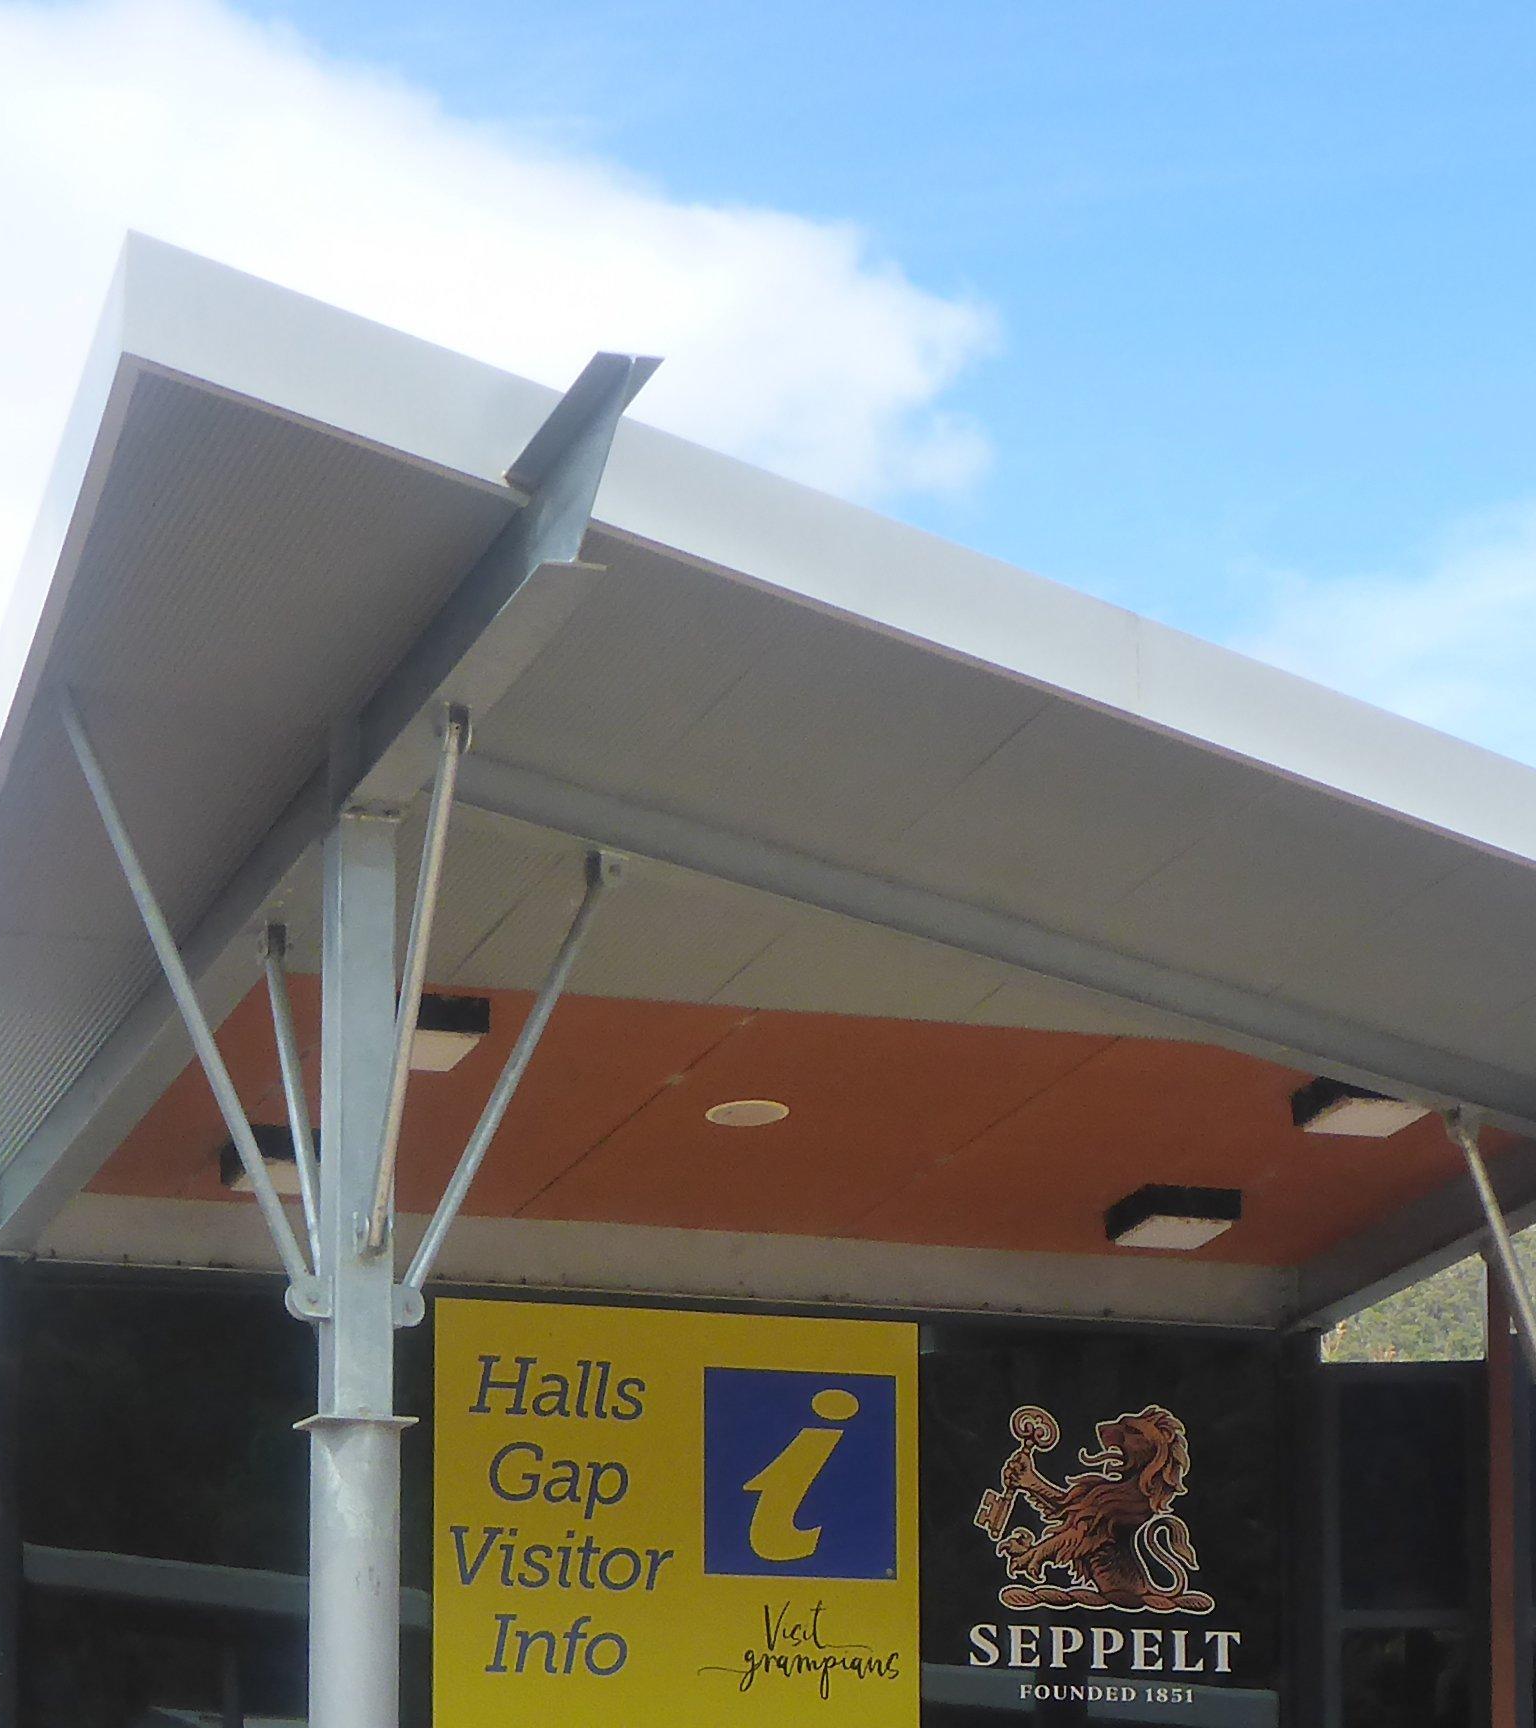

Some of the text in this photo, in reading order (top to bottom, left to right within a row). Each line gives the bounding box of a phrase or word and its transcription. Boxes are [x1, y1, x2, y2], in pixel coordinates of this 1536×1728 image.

[469, 1355, 646, 1421] Halls
[488, 1442, 630, 1519] Gap
[449, 1525, 674, 1591] Visitor
[484, 1614, 629, 1676] Info
[763, 1600, 872, 1652] Visit
[968, 1623, 1242, 1674] SEPPELT
[698, 1646, 901, 1700] grampians
[1019, 1683, 1196, 1704] FOUNDED 1851
